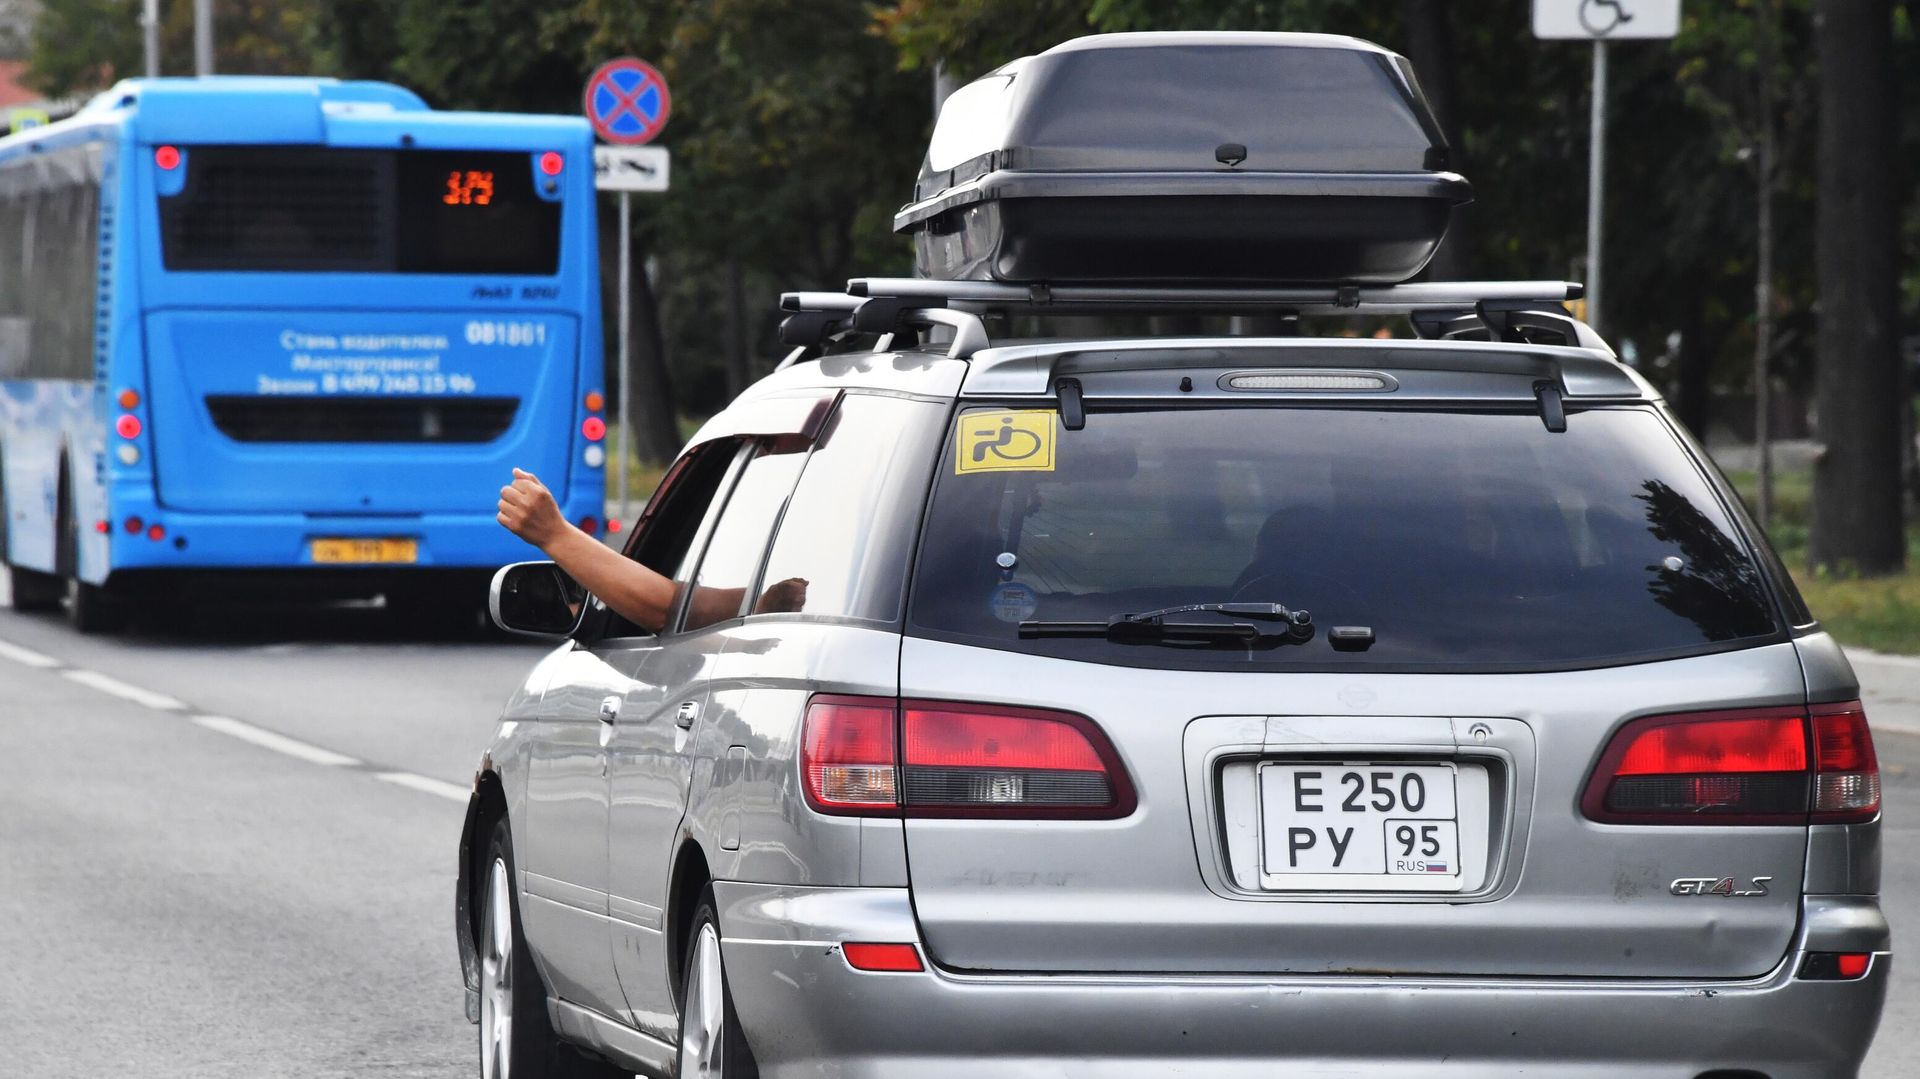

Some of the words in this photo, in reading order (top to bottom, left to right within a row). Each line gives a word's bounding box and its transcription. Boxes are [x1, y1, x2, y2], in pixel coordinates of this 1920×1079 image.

[1340, 772, 1426, 813] 250
[1395, 825, 1441, 857] 95
[1396, 861, 1425, 872] RUS
